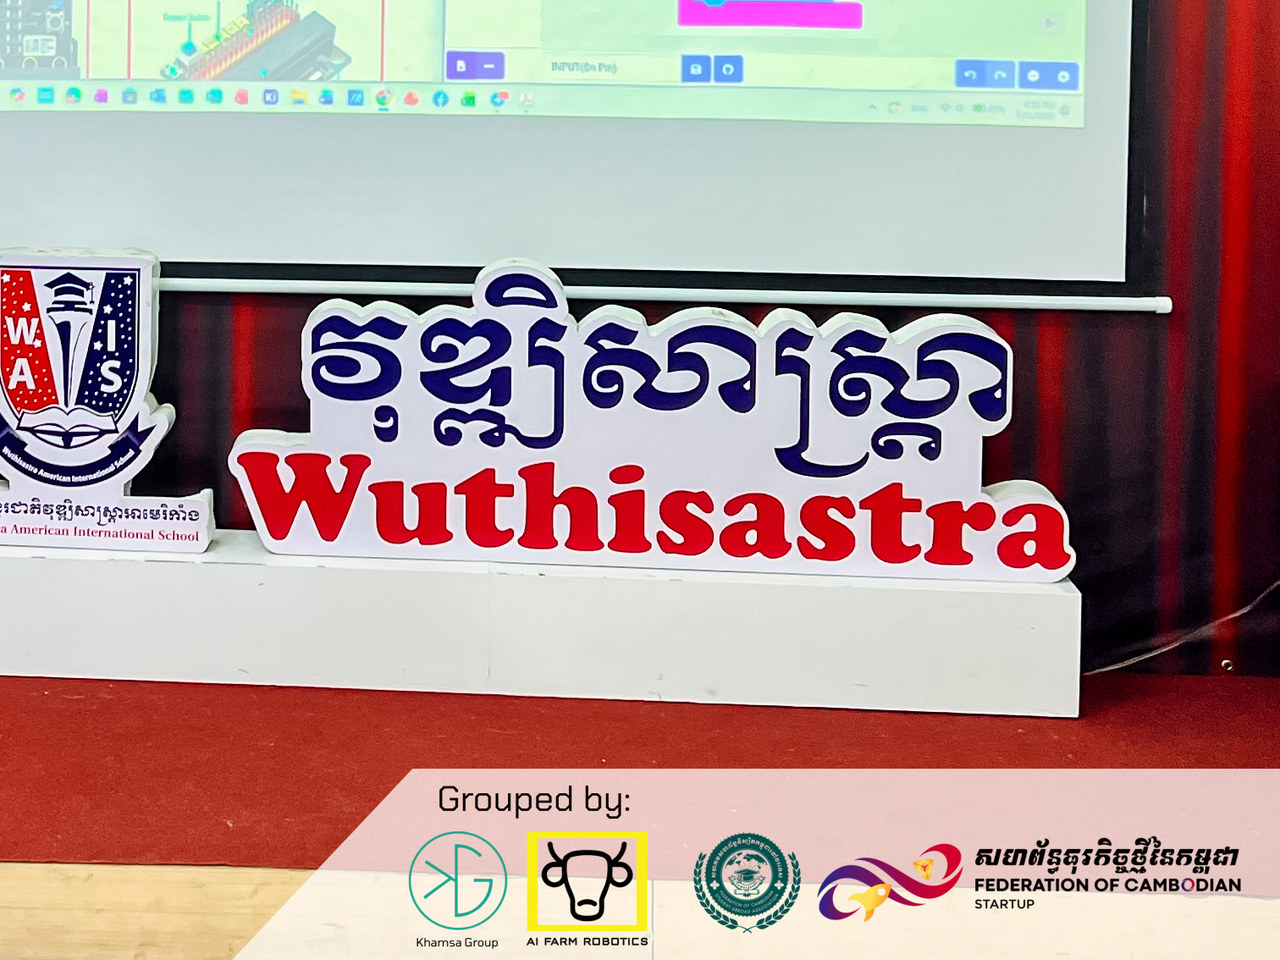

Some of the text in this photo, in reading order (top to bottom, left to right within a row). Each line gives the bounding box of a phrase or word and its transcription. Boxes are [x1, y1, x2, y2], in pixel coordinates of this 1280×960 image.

[5, 316, 39, 345] W
[107, 319, 116, 352] I
[8, 357, 36, 390] A
[100, 360, 122, 393] S
[2, 446, 39, 474] Wuthisastra
[38, 468, 71, 482] American
[72, 463, 116, 482] International
[236, 450, 1072, 571] Wuthisastra
[11, 524, 69, 536] American
[74, 526, 154, 540] International
[158, 529, 200, 542] School
